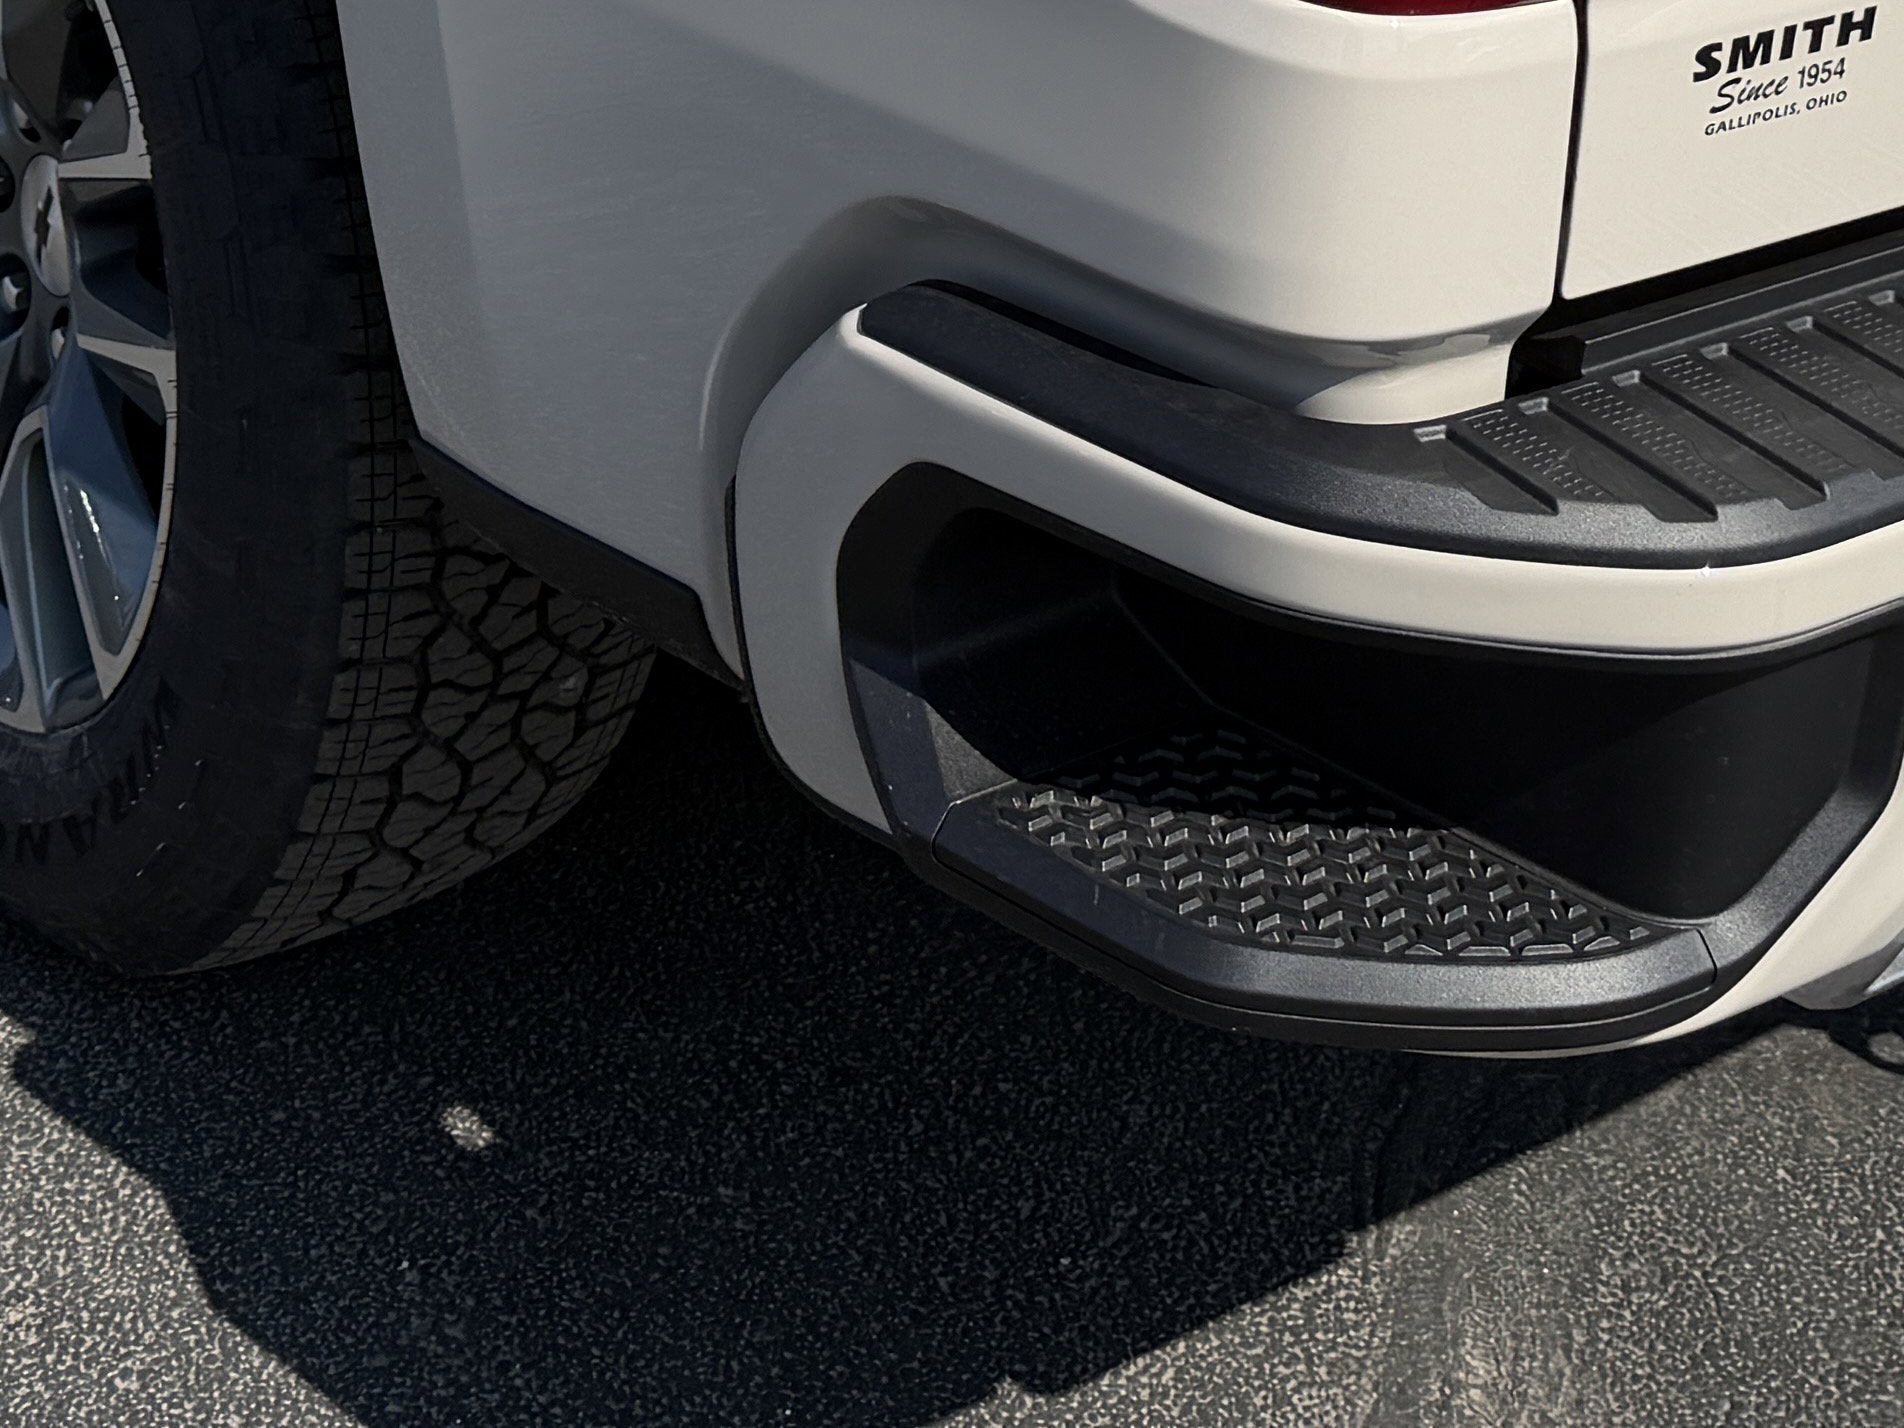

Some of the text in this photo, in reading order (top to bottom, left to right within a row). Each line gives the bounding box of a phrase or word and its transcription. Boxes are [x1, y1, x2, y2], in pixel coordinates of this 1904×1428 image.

[1693, 5, 1877, 82] SMITH
[1704, 90, 1847, 136] GALLIPOLIS, OHIO
[1709, 57, 1846, 114] Since 1954
